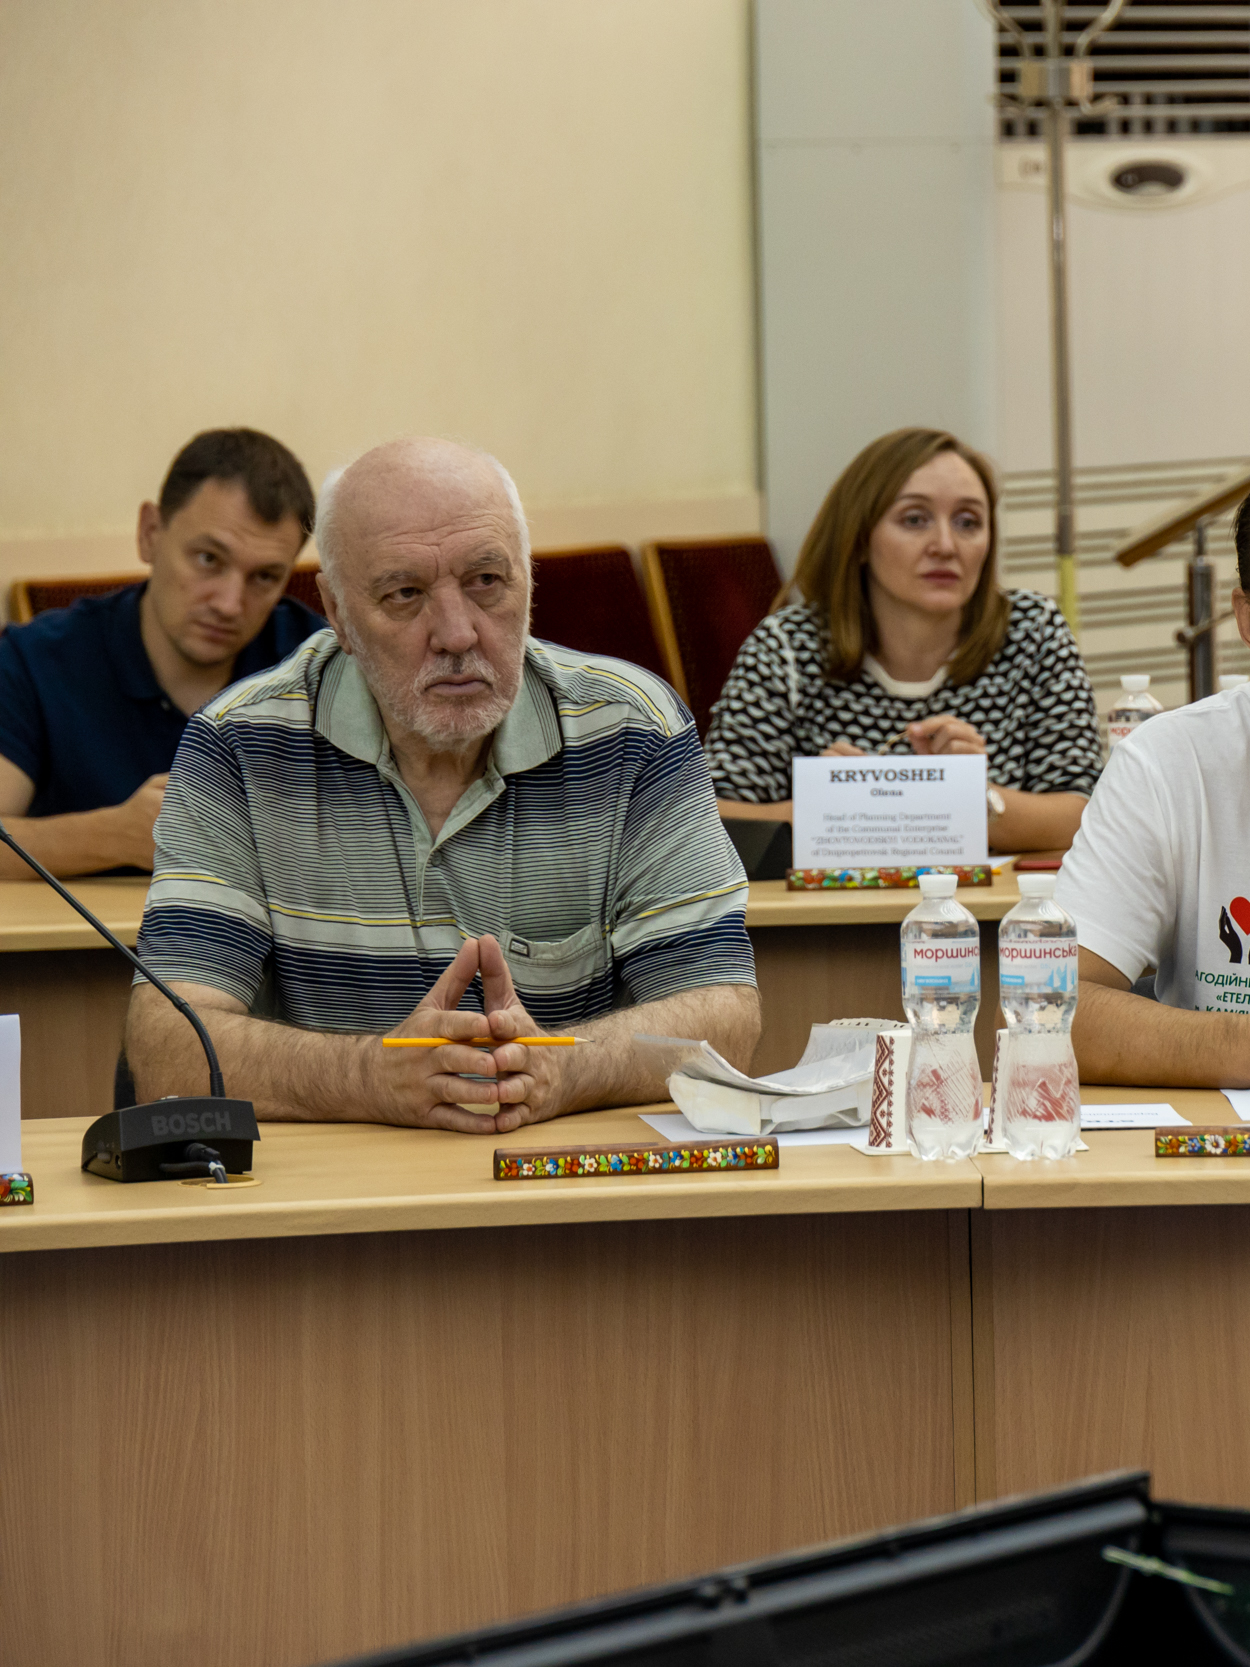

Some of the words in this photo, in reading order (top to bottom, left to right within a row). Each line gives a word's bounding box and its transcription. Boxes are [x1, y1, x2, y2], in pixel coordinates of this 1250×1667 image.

[829, 768, 946, 783] KRYVOSHEI
[858, 812, 897, 824] Planning
[899, 812, 952, 822] Department
[852, 824, 900, 833] Communal
[903, 824, 949, 834] Enterprise
[151, 1110, 232, 1137] BOSCH
